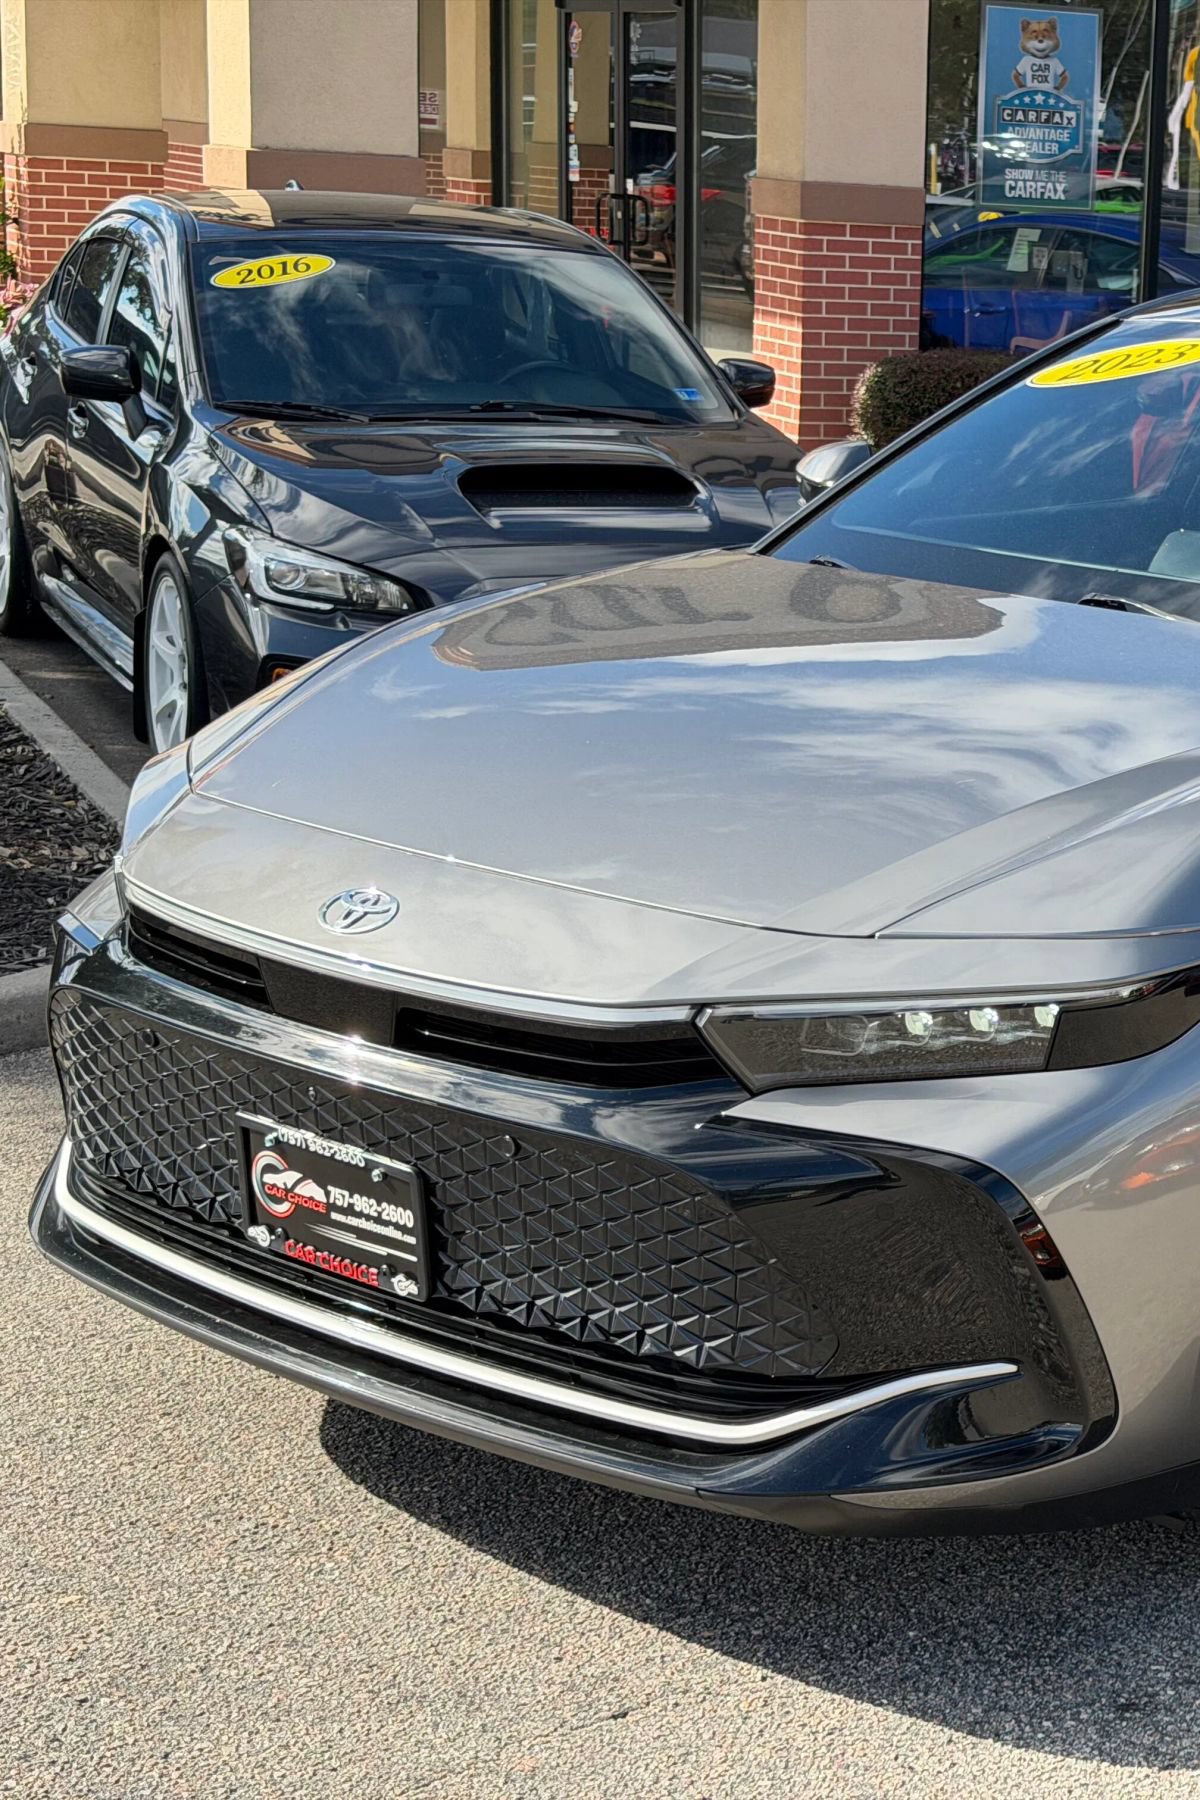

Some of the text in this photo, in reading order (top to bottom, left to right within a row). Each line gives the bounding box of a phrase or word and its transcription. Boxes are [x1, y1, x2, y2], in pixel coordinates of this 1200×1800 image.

[1030, 63, 1051, 73] CAR
[1031, 74, 1050, 84] FOX
[1002, 108, 1074, 126] CARFAX
[1007, 127, 1071, 141] ADVANTAGE
[1016, 142, 1059, 154] EALER
[1004, 168, 1067, 182] SHOW ME THE
[1004, 181, 1068, 200] CARFAX
[236, 256, 312, 284] 2016
[1055, 343, 1199, 382] 2023
[264, 1183, 328, 1214] CAR CHOICE
[327, 1184, 415, 1229] 757-962-2600
[284, 1238, 379, 1288] CAR CHOICE
